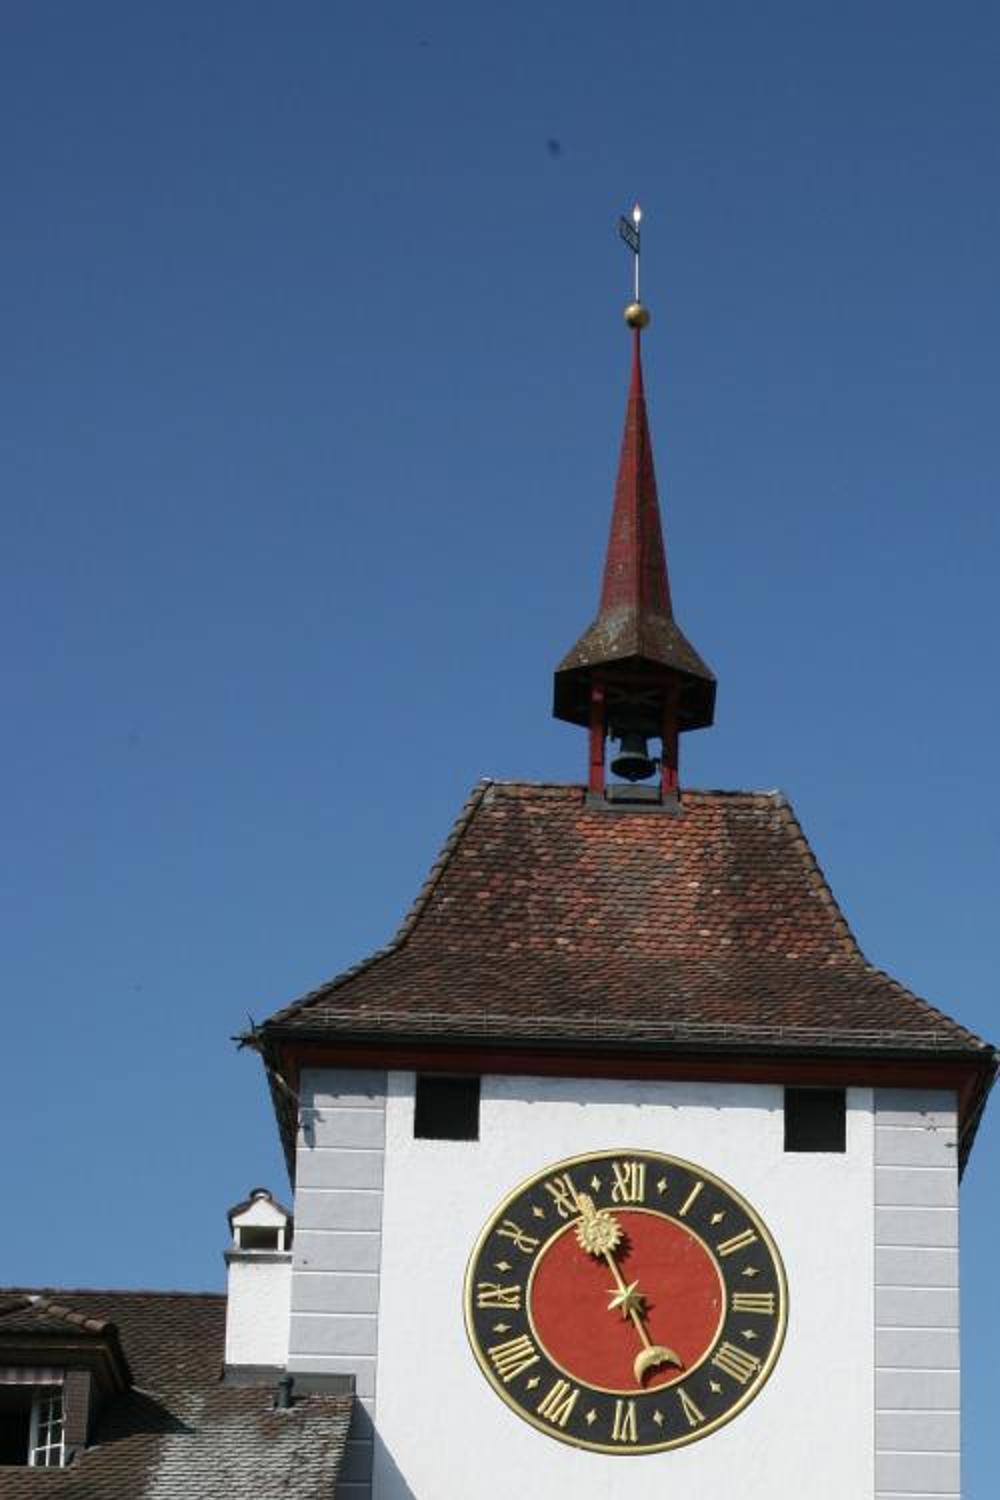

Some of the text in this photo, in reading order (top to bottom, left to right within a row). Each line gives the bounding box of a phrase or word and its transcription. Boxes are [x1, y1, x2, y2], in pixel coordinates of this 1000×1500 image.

[611, 1161, 647, 1203] XII
[732, 1292, 775, 1315] III
[537, 1379, 581, 1427] VII
[611, 1400, 638, 1442] VI
[676, 1387, 705, 1427] V
